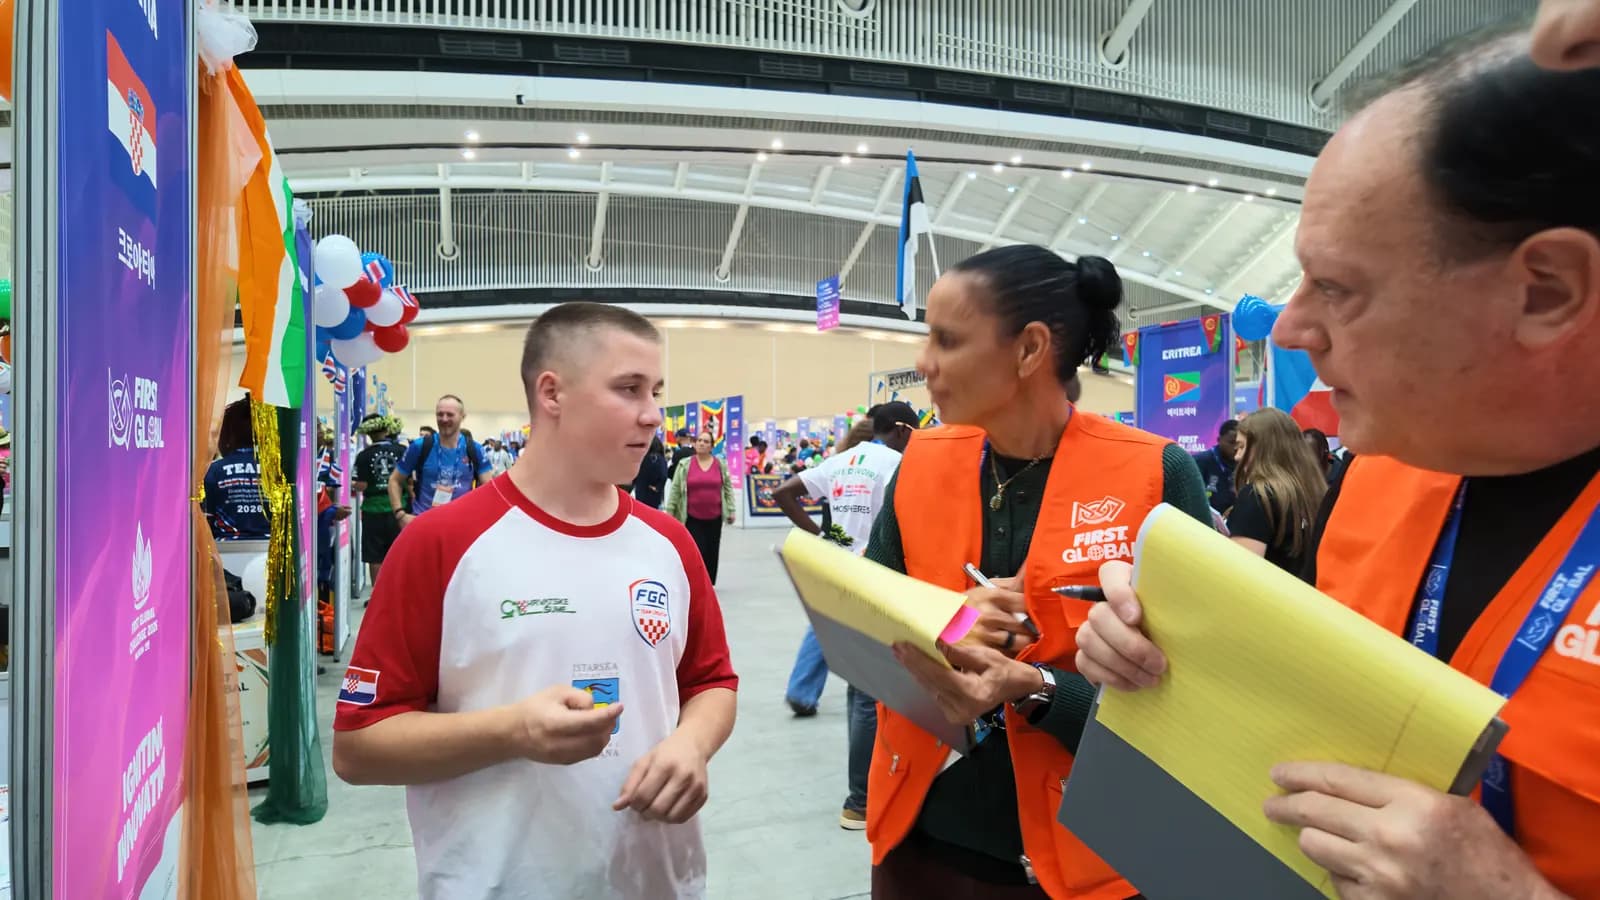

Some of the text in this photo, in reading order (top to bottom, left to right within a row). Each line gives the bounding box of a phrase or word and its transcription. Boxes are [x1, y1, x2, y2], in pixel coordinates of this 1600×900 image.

[1161, 345, 1202, 360] ERITREA
[1073, 526, 1129, 548] FIRST
[636, 589, 666, 606] FGC
[1539, 573, 1568, 609] FIRST
[1426, 599, 1440, 633] FIRST
[122, 715, 163, 813] IGNITIN
[117, 746, 166, 883] INNOVATI
